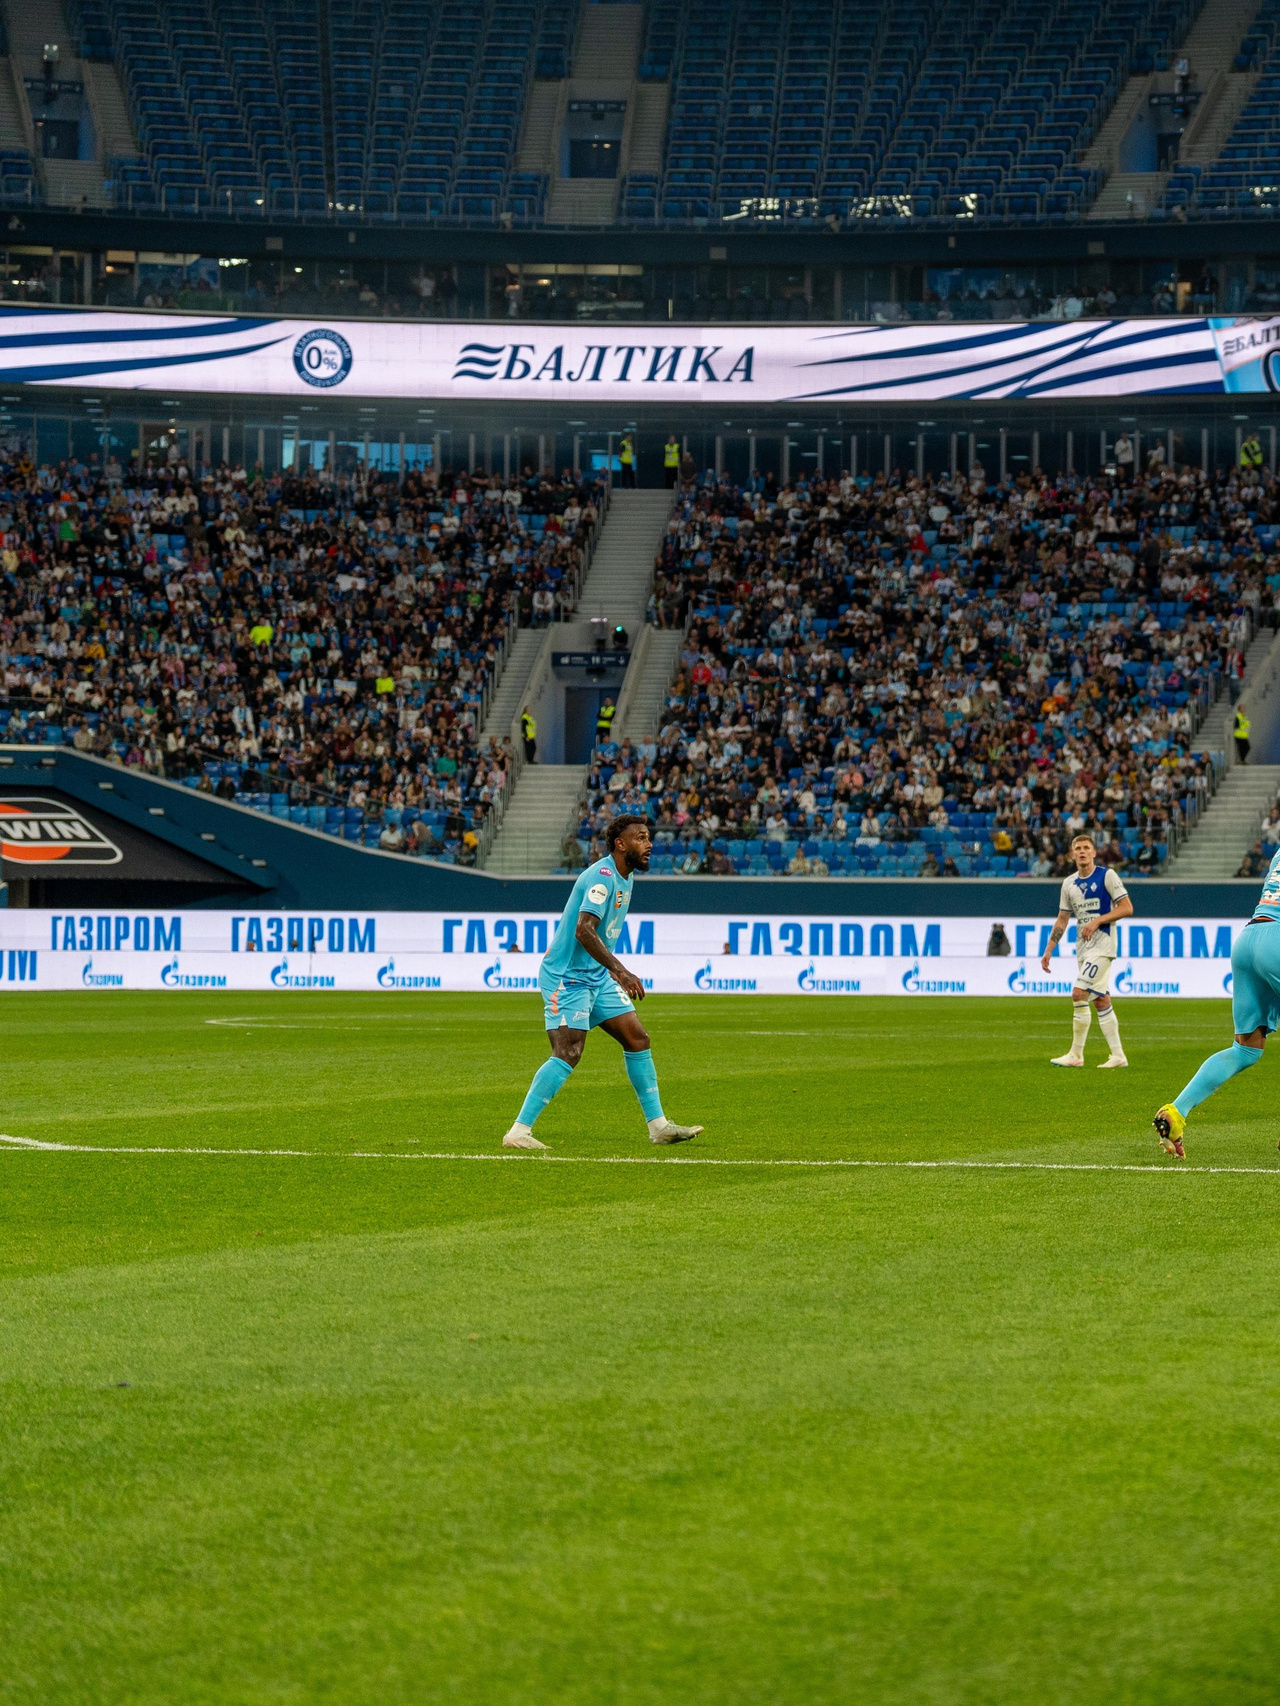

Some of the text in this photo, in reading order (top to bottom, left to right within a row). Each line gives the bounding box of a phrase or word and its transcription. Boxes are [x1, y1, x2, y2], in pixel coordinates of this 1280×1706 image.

[499, 344, 754, 382] БАЛТИКА
[51, 916, 181, 950] ГАЗПРОМ
[231, 917, 376, 952] ГАЗПРОМ
[442, 919, 656, 954] ГАЗПМ
[728, 922, 941, 956] ГАЗПРОМ
[1082, 961, 1099, 979] 70
[180, 975, 226, 986] ГАЗПРОМ
[290, 976, 335, 987] ГАЗПРОМ
[396, 976, 441, 987] ГАЗПРОМ
[501, 976, 538, 988] ГАЗПРО
[711, 978, 757, 990] ГАЗПРОМ
[815, 980, 860, 991] ГАЗПРОМ
[924, 980, 966, 992] ГАЗПРОМ
[1026, 981, 1072, 994] ГАЗПРОМ
[1133, 982, 1179, 994] ГАЗПРОМ
